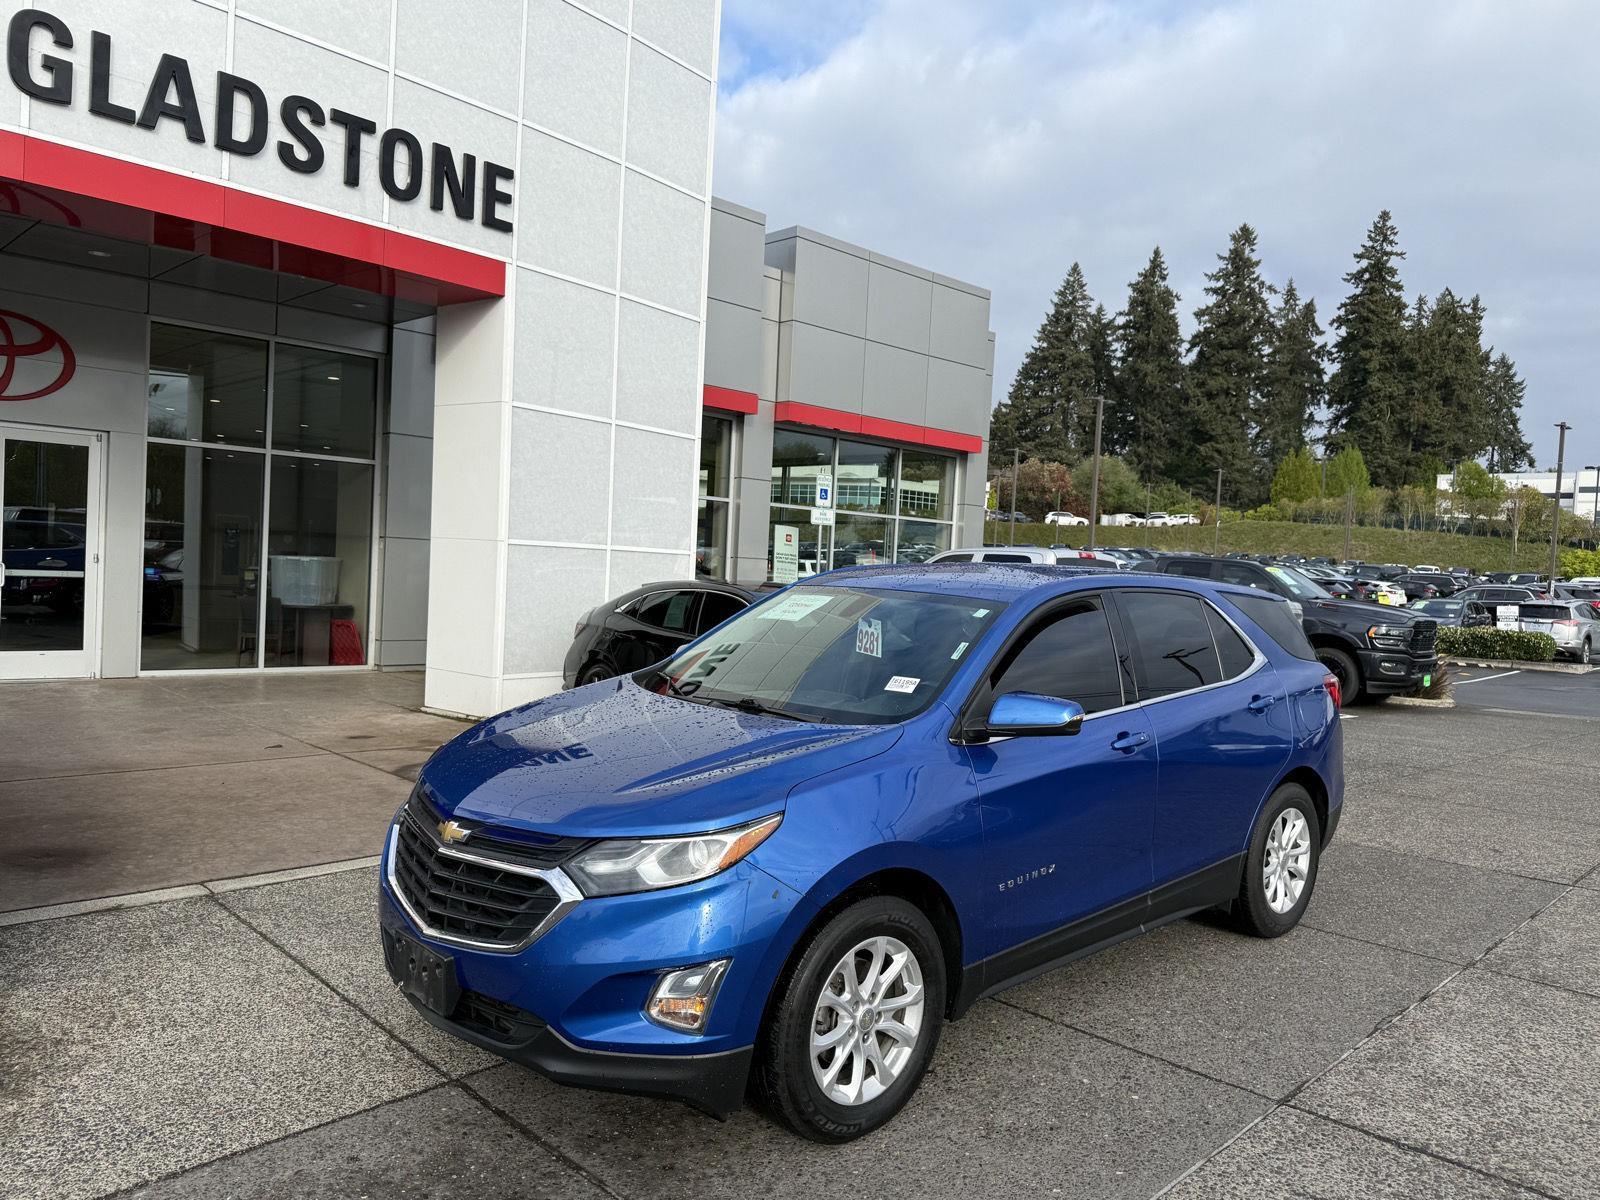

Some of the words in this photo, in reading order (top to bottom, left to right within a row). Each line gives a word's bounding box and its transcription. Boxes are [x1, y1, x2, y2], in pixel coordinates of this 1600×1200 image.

[7, 9, 514, 233] GLADSTONE
[857, 628, 880, 656] 9281
[998, 863, 1056, 892] EQUINOX
